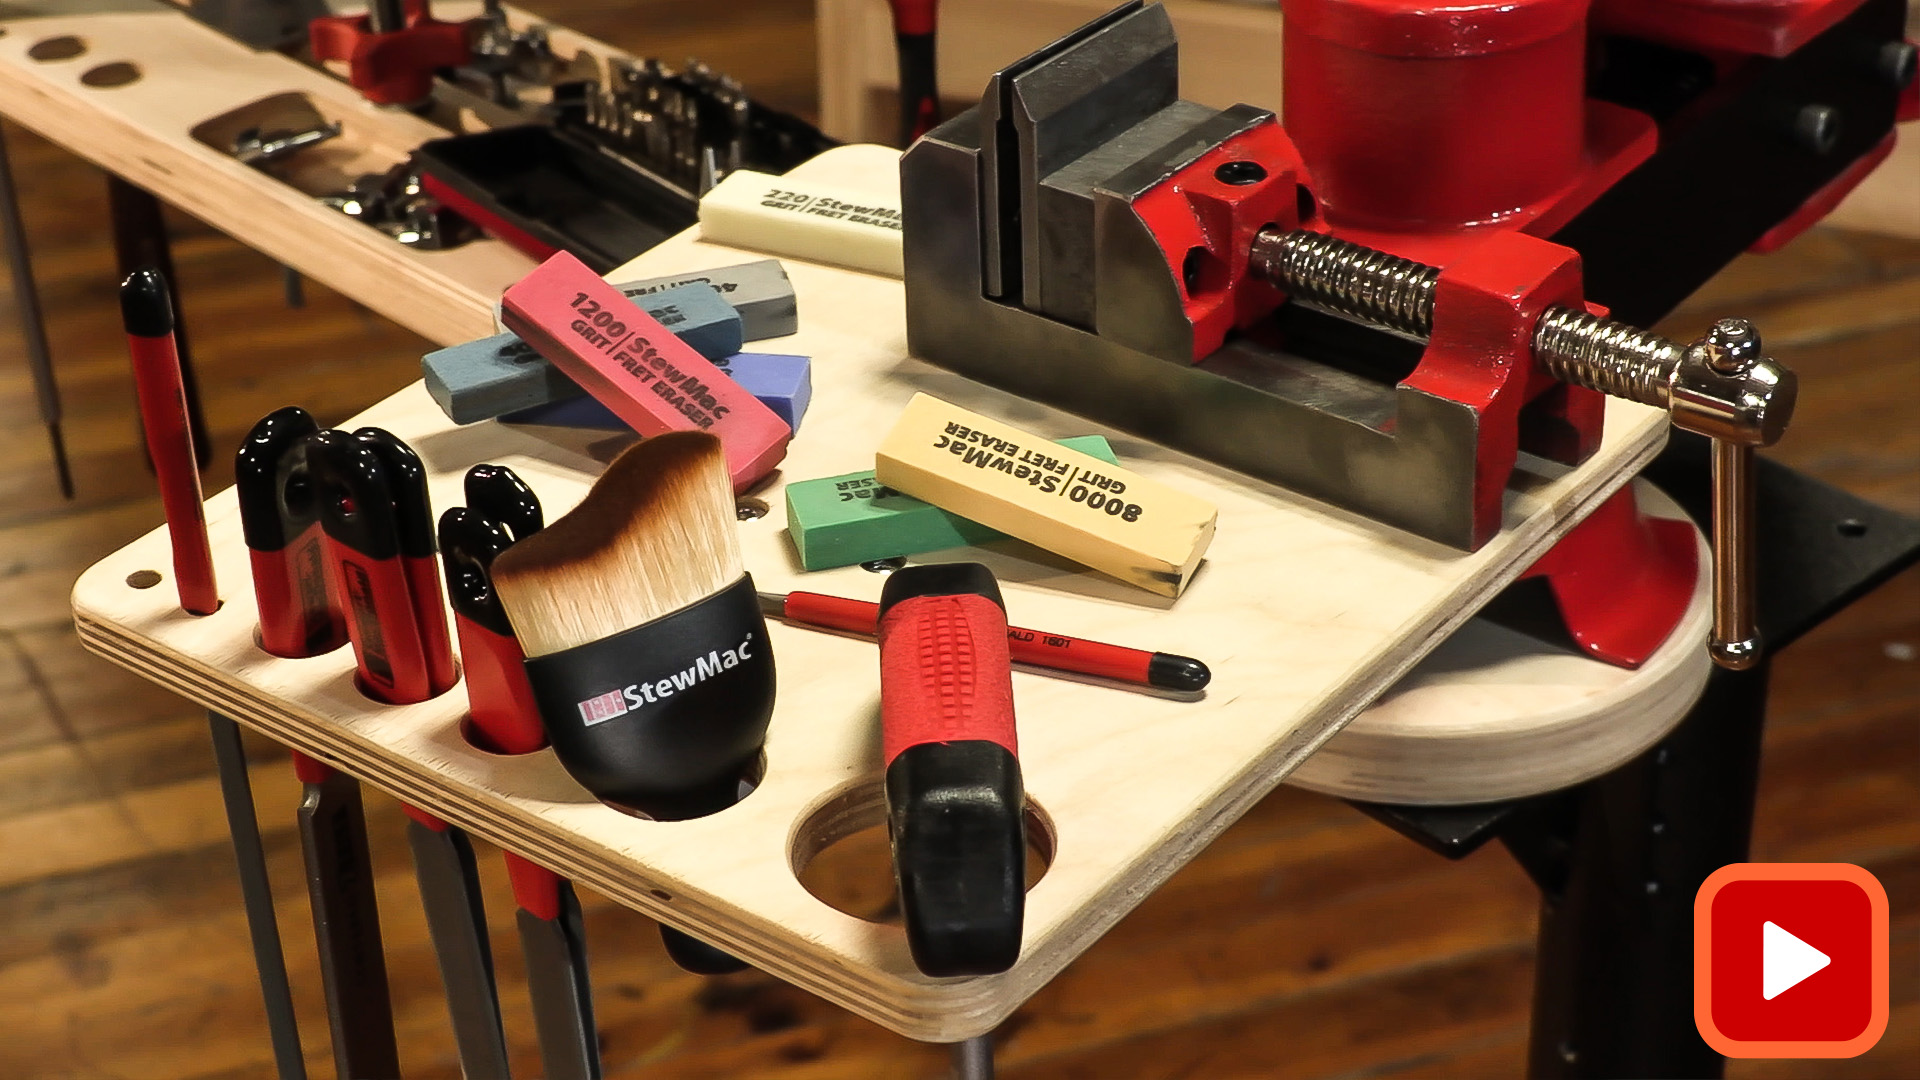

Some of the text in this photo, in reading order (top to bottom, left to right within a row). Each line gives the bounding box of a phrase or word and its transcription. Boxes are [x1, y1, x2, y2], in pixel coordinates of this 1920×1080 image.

[760, 200, 903, 231] GRIT FRET ERASE
[763, 189, 902, 220] 220 StewMa
[570, 292, 731, 420] 1200 StewMac
[571, 319, 714, 430] GRIT FRET ERASER
[933, 434, 1143, 523] 8000 StewMac
[944, 421, 1126, 494] GRIT FRET ERASER
[623, 640, 752, 711] StewMac
